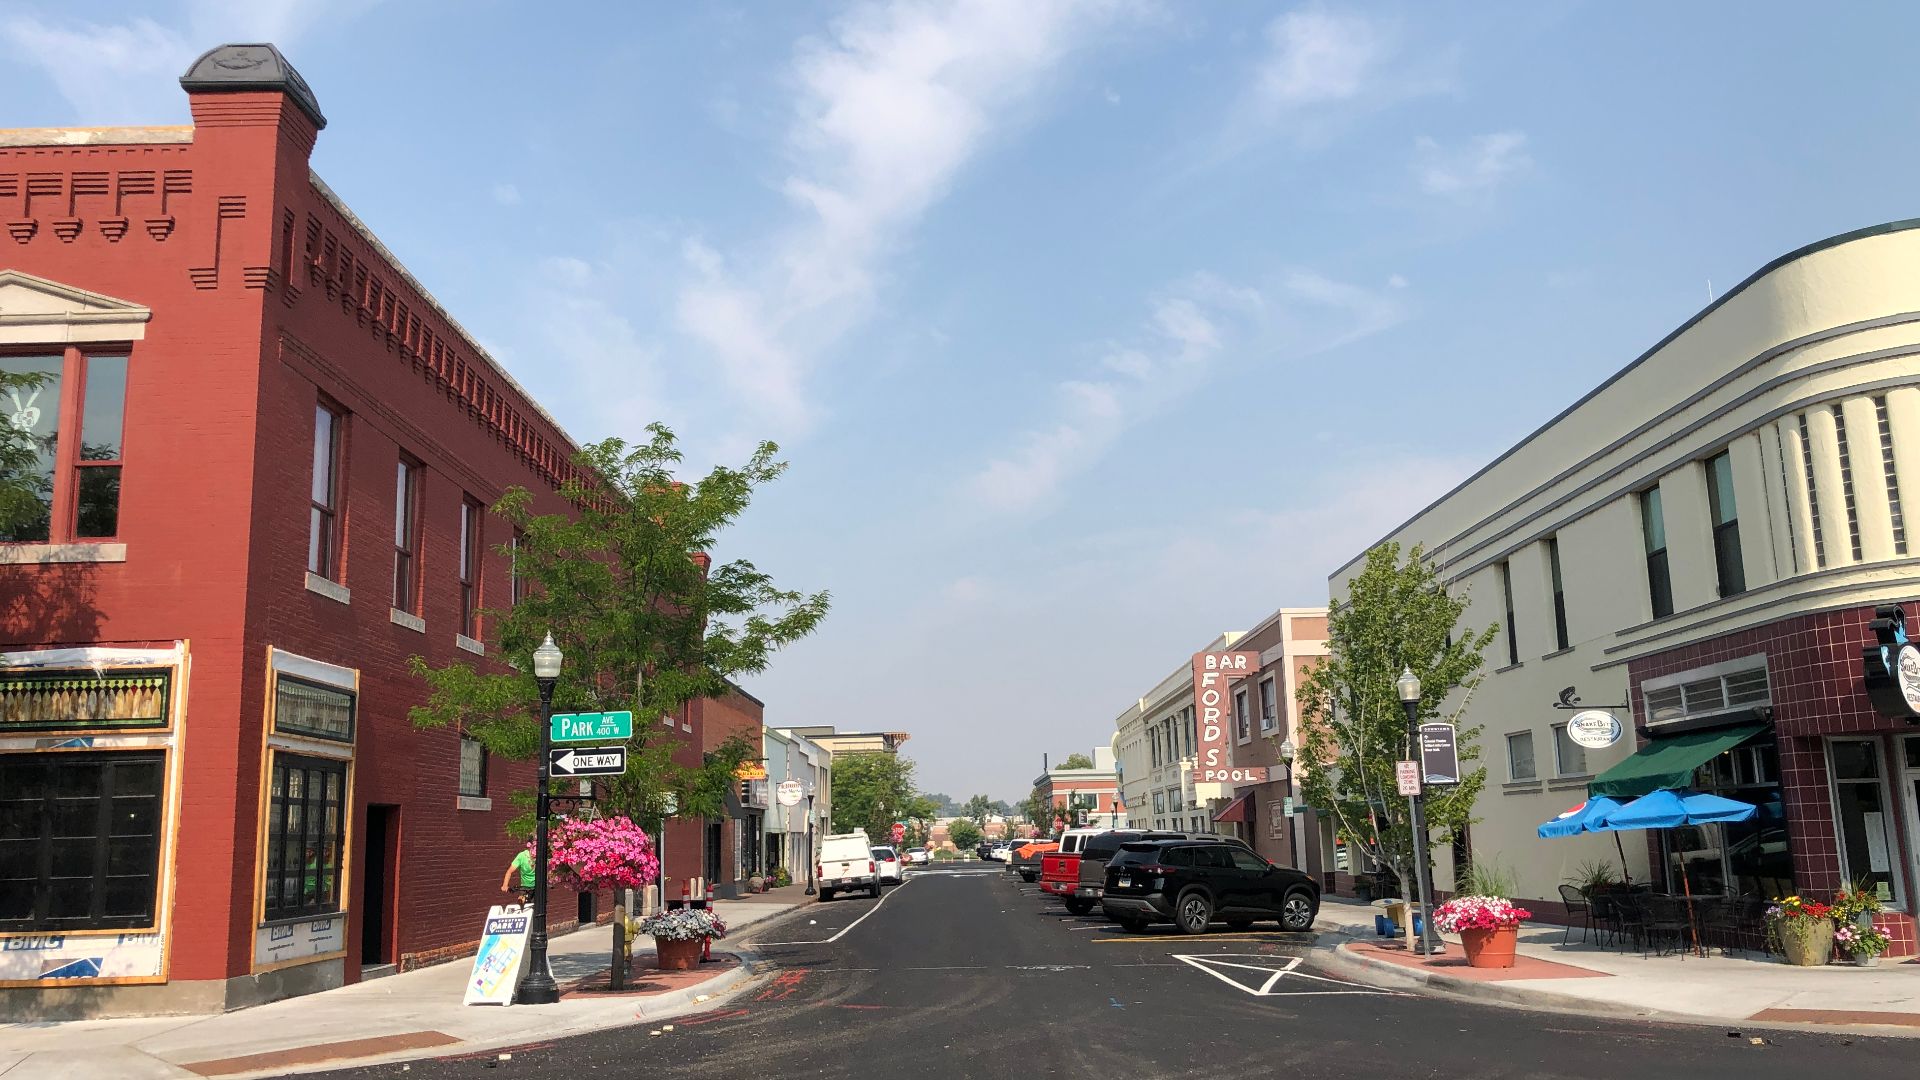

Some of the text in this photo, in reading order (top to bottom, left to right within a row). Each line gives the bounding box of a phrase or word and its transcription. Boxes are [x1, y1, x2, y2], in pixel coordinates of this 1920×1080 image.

[1205, 655, 1247, 670] BAR
[601, 715, 615, 725] AVE
[561, 717, 594, 738] PARK
[596, 726, 620, 736] 400 W
[573, 755, 617, 767] ONE WAY
[1205, 770, 1258, 782] POOL
[8, 935, 59, 949] BMC
